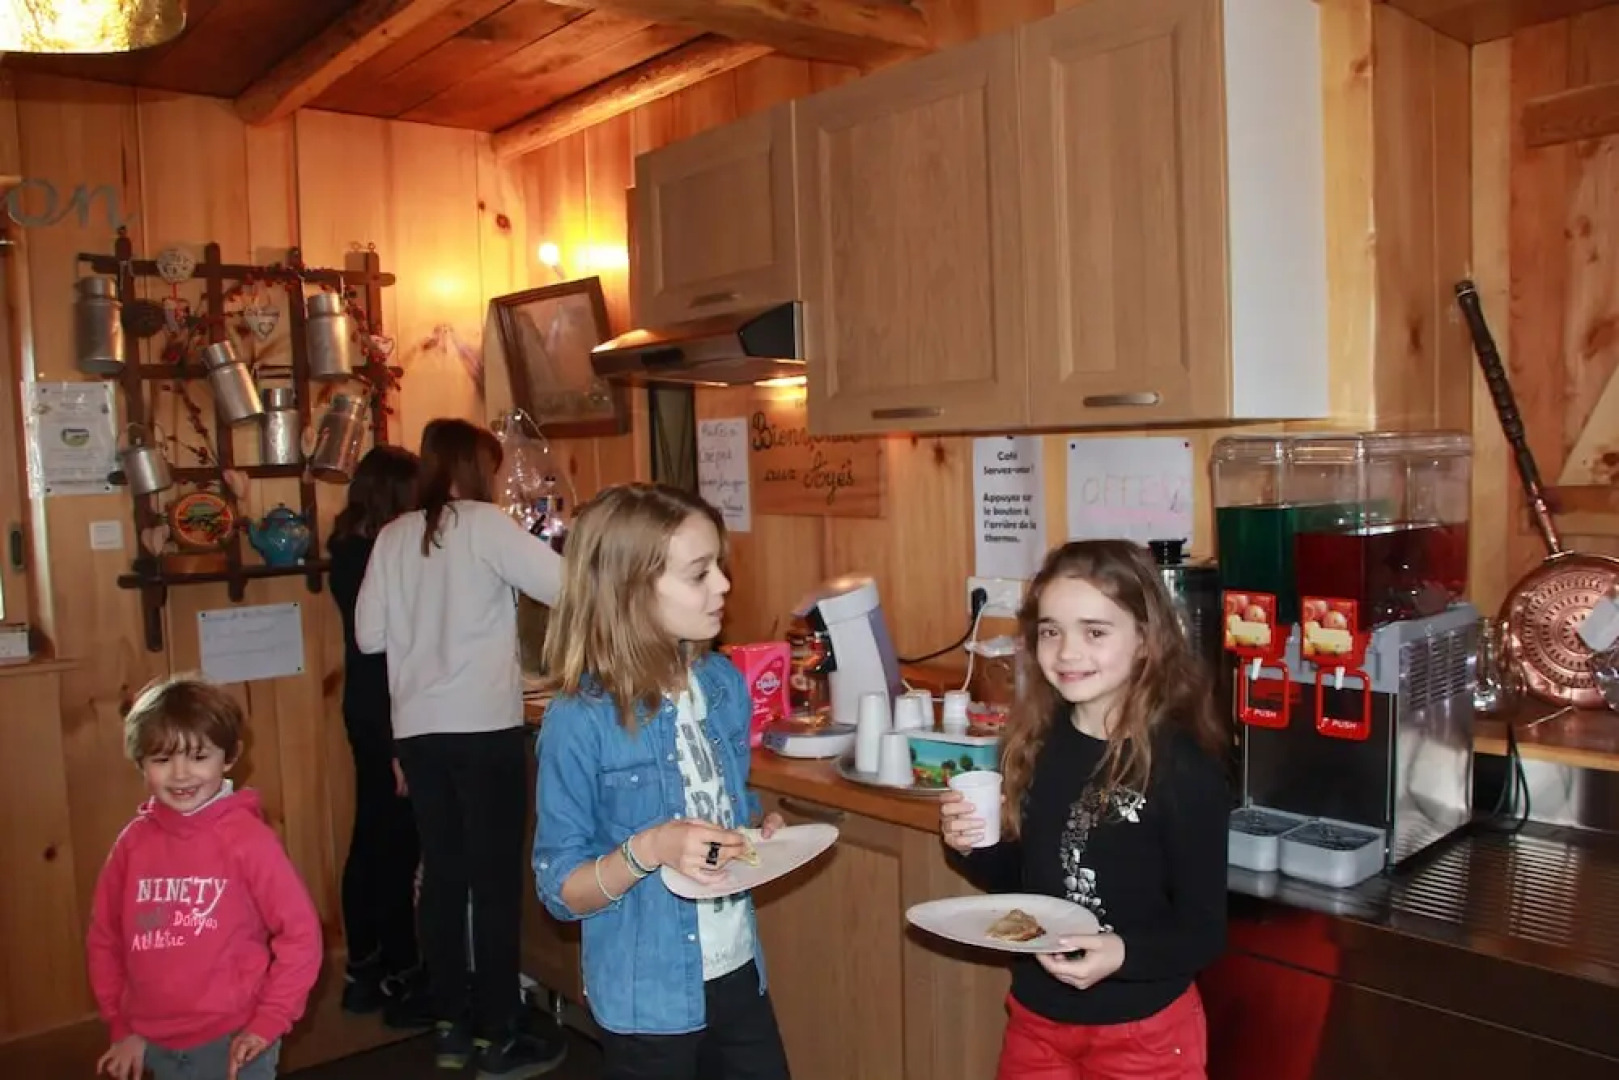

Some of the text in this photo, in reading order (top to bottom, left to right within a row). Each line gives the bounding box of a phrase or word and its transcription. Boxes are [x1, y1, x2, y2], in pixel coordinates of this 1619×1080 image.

[993, 507, 1022, 515] bouton
[1254, 709, 1277, 718] PUSH
[1332, 719, 1357, 729] PUSH
[136, 876, 228, 917] NINETY
